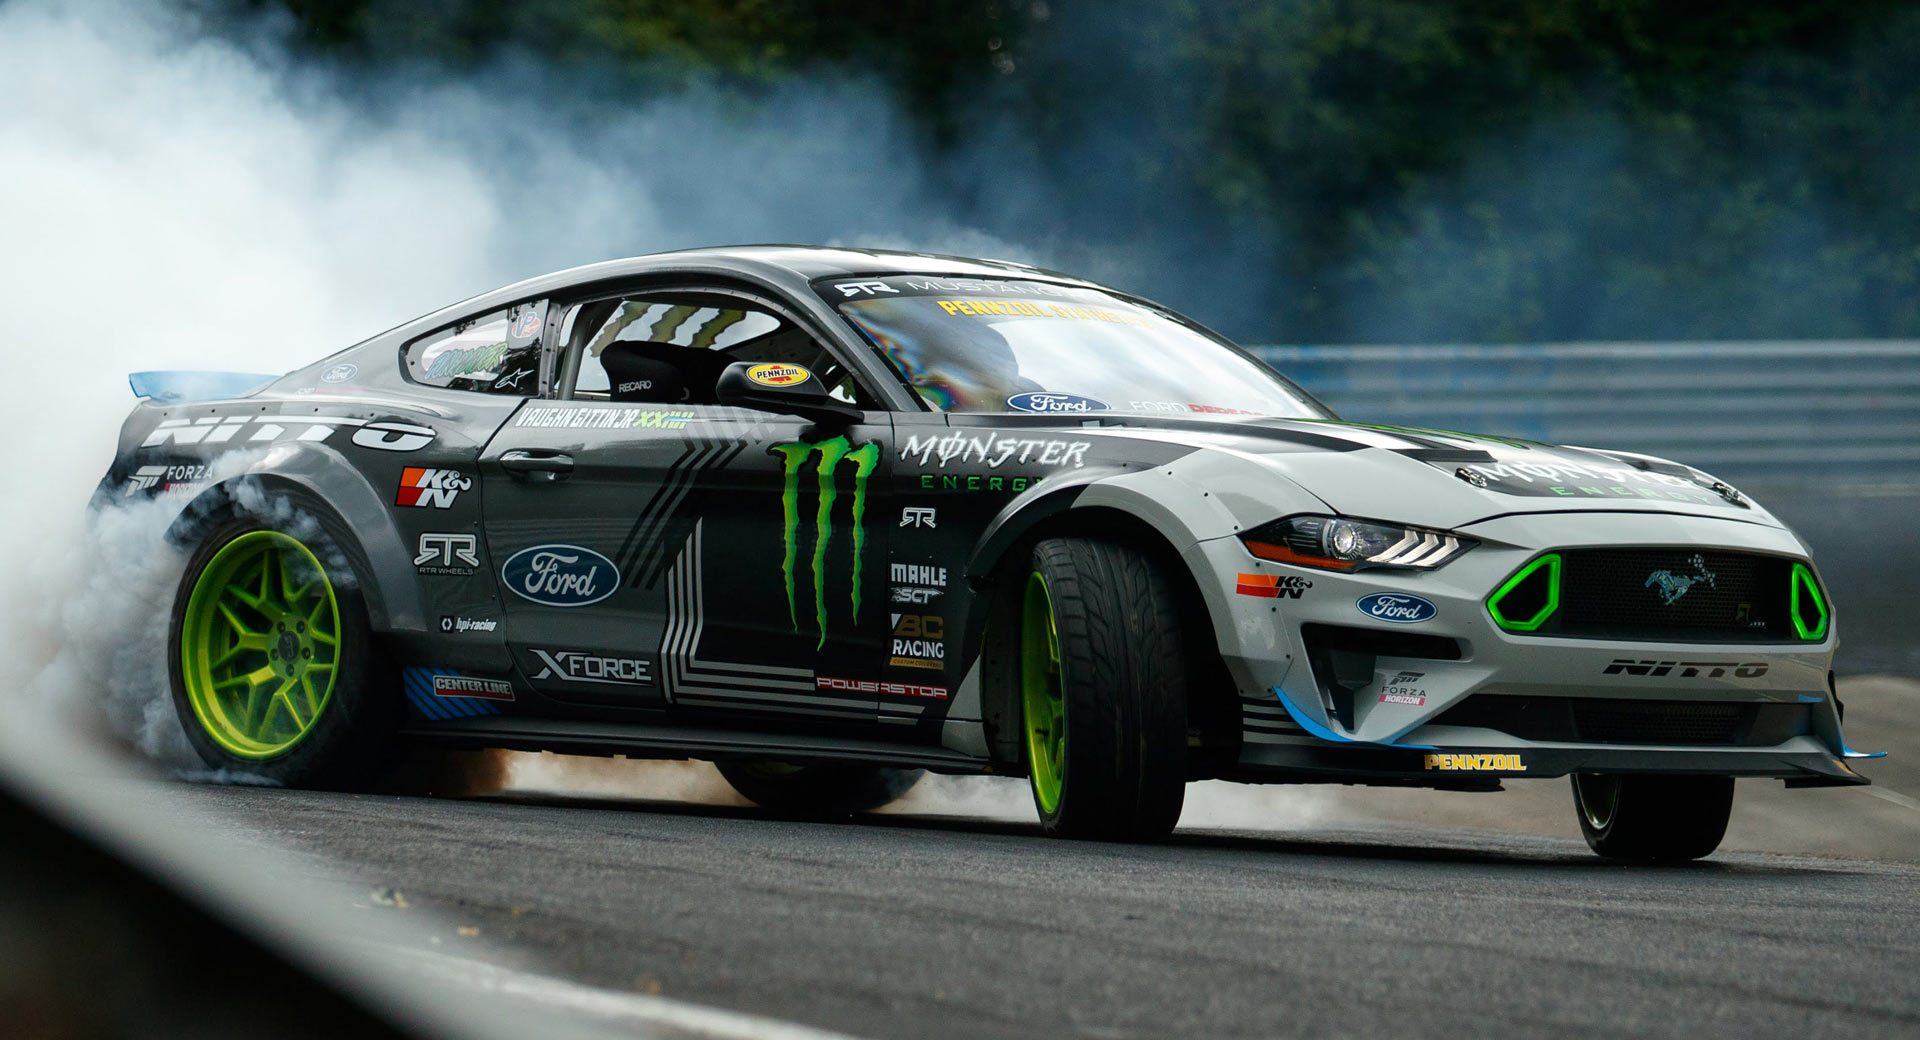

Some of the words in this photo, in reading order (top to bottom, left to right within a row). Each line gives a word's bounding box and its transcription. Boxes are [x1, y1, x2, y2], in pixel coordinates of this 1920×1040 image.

[905, 281, 1064, 297] MUSTANG
[936, 299, 1055, 319] PENNZOIL
[756, 368, 799, 379] PENNZOIL
[618, 380, 652, 394] RECARO
[1029, 393, 1092, 412] Ford
[515, 407, 575, 428] VAUGHN
[140, 415, 437, 452] NITTO
[166, 465, 214, 480] FORZA
[416, 468, 473, 509] K&N
[920, 475, 1050, 493] ENERGY
[419, 567, 437, 575] RTR
[438, 567, 473, 576] WHEELS
[525, 551, 598, 597] Ford
[891, 563, 947, 586] MAHLE
[898, 587, 930, 605] SCT
[1274, 575, 1314, 600] K&N
[1371, 595, 1420, 620] Ford
[455, 617, 498, 633] hpi-racing
[893, 614, 945, 638] BC
[893, 639, 945, 659] RACING
[1602, 658, 1769, 678] NITTO
[435, 678, 484, 693] CENTER
[483, 681, 511, 695] LINE
[816, 677, 948, 698] POWERSTOP
[1381, 686, 1427, 697] FORZA
[1384, 695, 1421, 705] HORIZON
[1424, 753, 1527, 771] PENNZOIL
